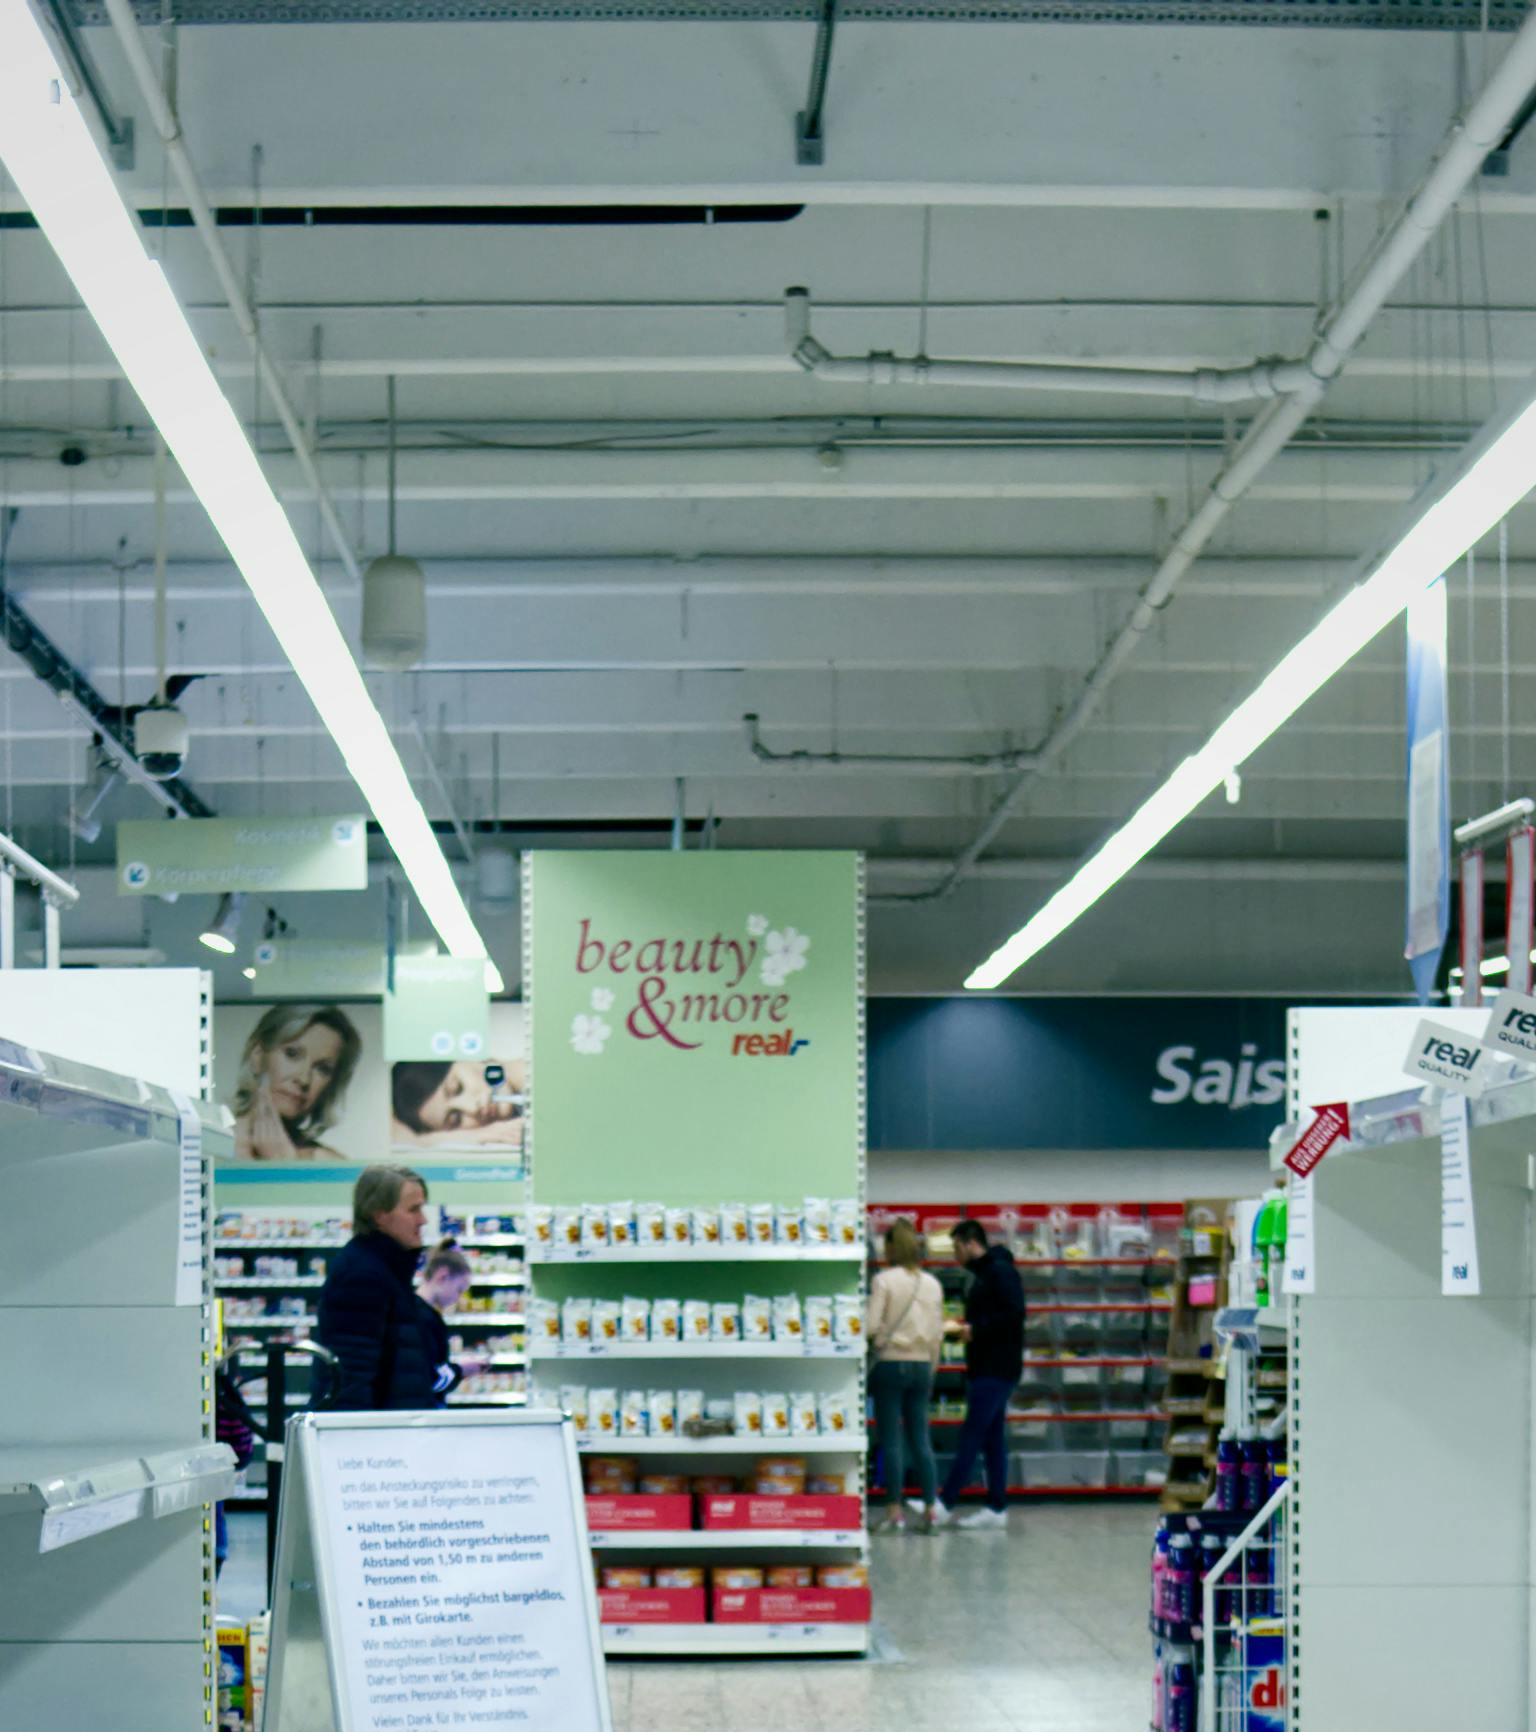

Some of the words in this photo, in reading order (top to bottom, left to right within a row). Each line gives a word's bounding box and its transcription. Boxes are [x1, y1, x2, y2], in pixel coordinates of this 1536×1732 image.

[576, 918, 757, 988] beauty
[626, 977, 703, 1050] &
[681, 991, 790, 1023] more
[1423, 1037, 1481, 1070] real
[1418, 1060, 1471, 1083] QUALITY
[337, 1458, 363, 1470] Liebe
[367, 1457, 408, 1469] Kunden,
[341, 1484, 356, 1494] um
[360, 1481, 377, 1493] das
[380, 1479, 469, 1493] Ansteckungsrisiko
[471, 1479, 484, 1489] zu
[343, 1498, 373, 1511] bitten
[376, 1500, 391, 1509] wir
[394, 1497, 409, 1509] Sie
[412, 1496, 428, 1508] auf
[431, 1495, 481, 1510] Folgendes
[484, 1497, 495, 1506] zu
[357, 1520, 395, 1533] Halten
[398, 1519, 416, 1532] Sie
[419, 1518, 485, 1531] mindestens
[360, 1538, 381, 1551] den
[385, 1536, 445, 1550] behördlich
[449, 1532, 551, 1549] vorgeschriebenen
[363, 1555, 410, 1568] Abstand
[413, 1556, 434, 1566] von
[438, 1553, 462, 1567] 1,50
[466, 1554, 477, 1564] m
[480, 1553, 493, 1563] zu
[496, 1550, 543, 1562] anderen
[364, 1573, 417, 1586] Personen
[420, 1572, 442, 1583] ein.
[367, 1596, 420, 1610] Bezahlen
[423, 1594, 440, 1607] Sie
[444, 1592, 500, 1608] möglichst
[503, 1589, 566, 1604] bargeldlos,
[370, 1615, 390, 1628] z.B.
[392, 1614, 412, 1625] mit
[415, 1612, 473, 1625] Girokarte.
[362, 1639, 380, 1650] Wir
[383, 1637, 427, 1649] möchten
[430, 1635, 454, 1647] allen
[457, 1634, 495, 1646] Kunden
[497, 1633, 525, 1644] einen
[439, 1651, 476, 1664] Einkauf
[367, 1674, 397, 1687] Daher
[400, 1672, 430, 1685] bitten
[432, 1671, 448, 1682] wir
[471, 1669, 490, 1680] den
[493, 1666, 560, 1681] Anweisungen
[370, 1691, 408, 1704] unseres
[411, 1689, 458, 1702] Personals
[461, 1688, 488, 1701] Folge
[490, 1687, 502, 1697] zu
[372, 1715, 405, 1728] Vielen
[407, 1713, 433, 1726] Dank
[436, 1711, 451, 1724] für
[454, 1711, 466, 1723] Ihr
